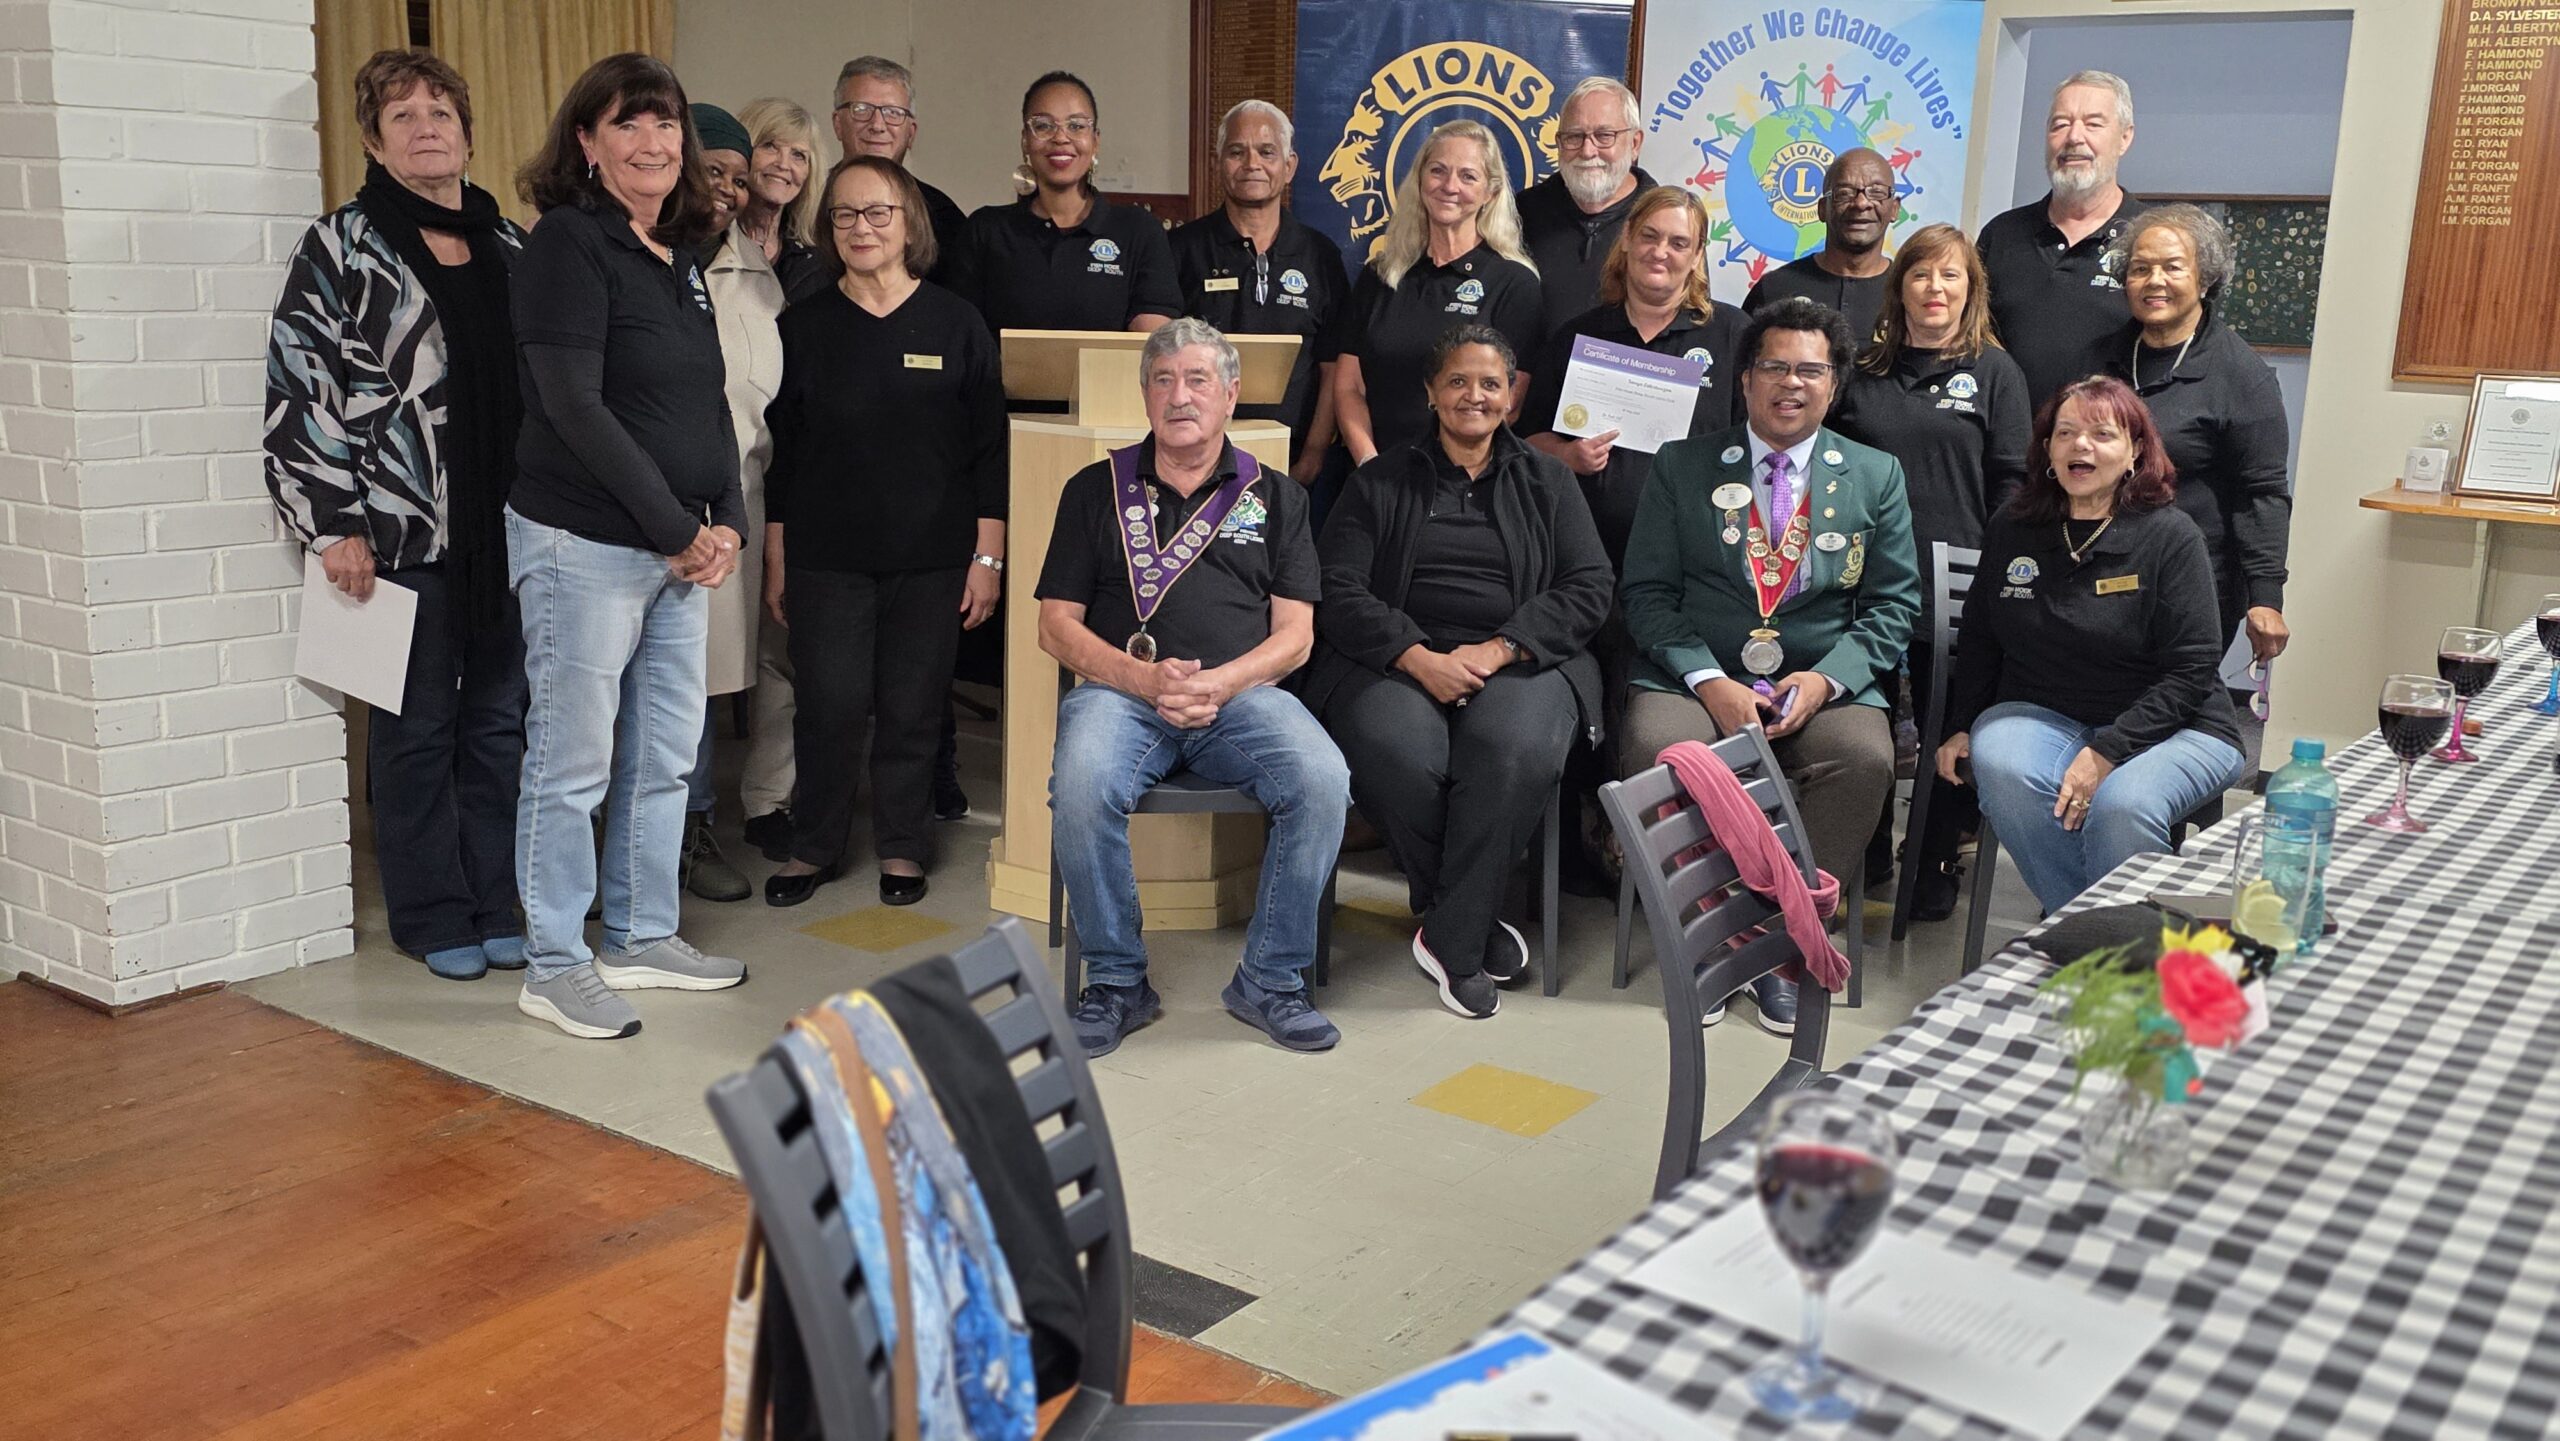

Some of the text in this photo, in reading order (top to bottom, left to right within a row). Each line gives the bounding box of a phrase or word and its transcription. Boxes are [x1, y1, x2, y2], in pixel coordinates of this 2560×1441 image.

[2472, 0, 2535, 8] BRONWYN
[1762, 9, 1805, 42] We
[1815, 7, 1911, 67] Change
[2466, 36, 2560, 47] M.H. ALBERTYN
[2478, 48, 2544, 58] HAMMOND
[2477, 60, 2543, 70] HAMMOND
[1384, 48, 1543, 110] LIONS
[2476, 71, 2533, 80] MORGAN
[2476, 117, 2525, 126] FORGAN
[2475, 128, 2523, 136] FORGAN
[2478, 139, 2509, 148] RYAN
[1781, 145, 1831, 162] LIONS
[2476, 150, 2507, 158] RYAN
[2471, 162, 2519, 170] FORGAN
[2469, 172, 2518, 182] FORGAN
[1793, 168, 1816, 197] L
[2472, 184, 2511, 192] RANFT
[2470, 195, 2511, 204] RANFT
[1777, 204, 1818, 220] INTERNATION
[2464, 206, 2512, 214] FORGAN
[2462, 216, 2511, 226] FORGAN
[1583, 348, 1676, 376] Certificate of Membership
